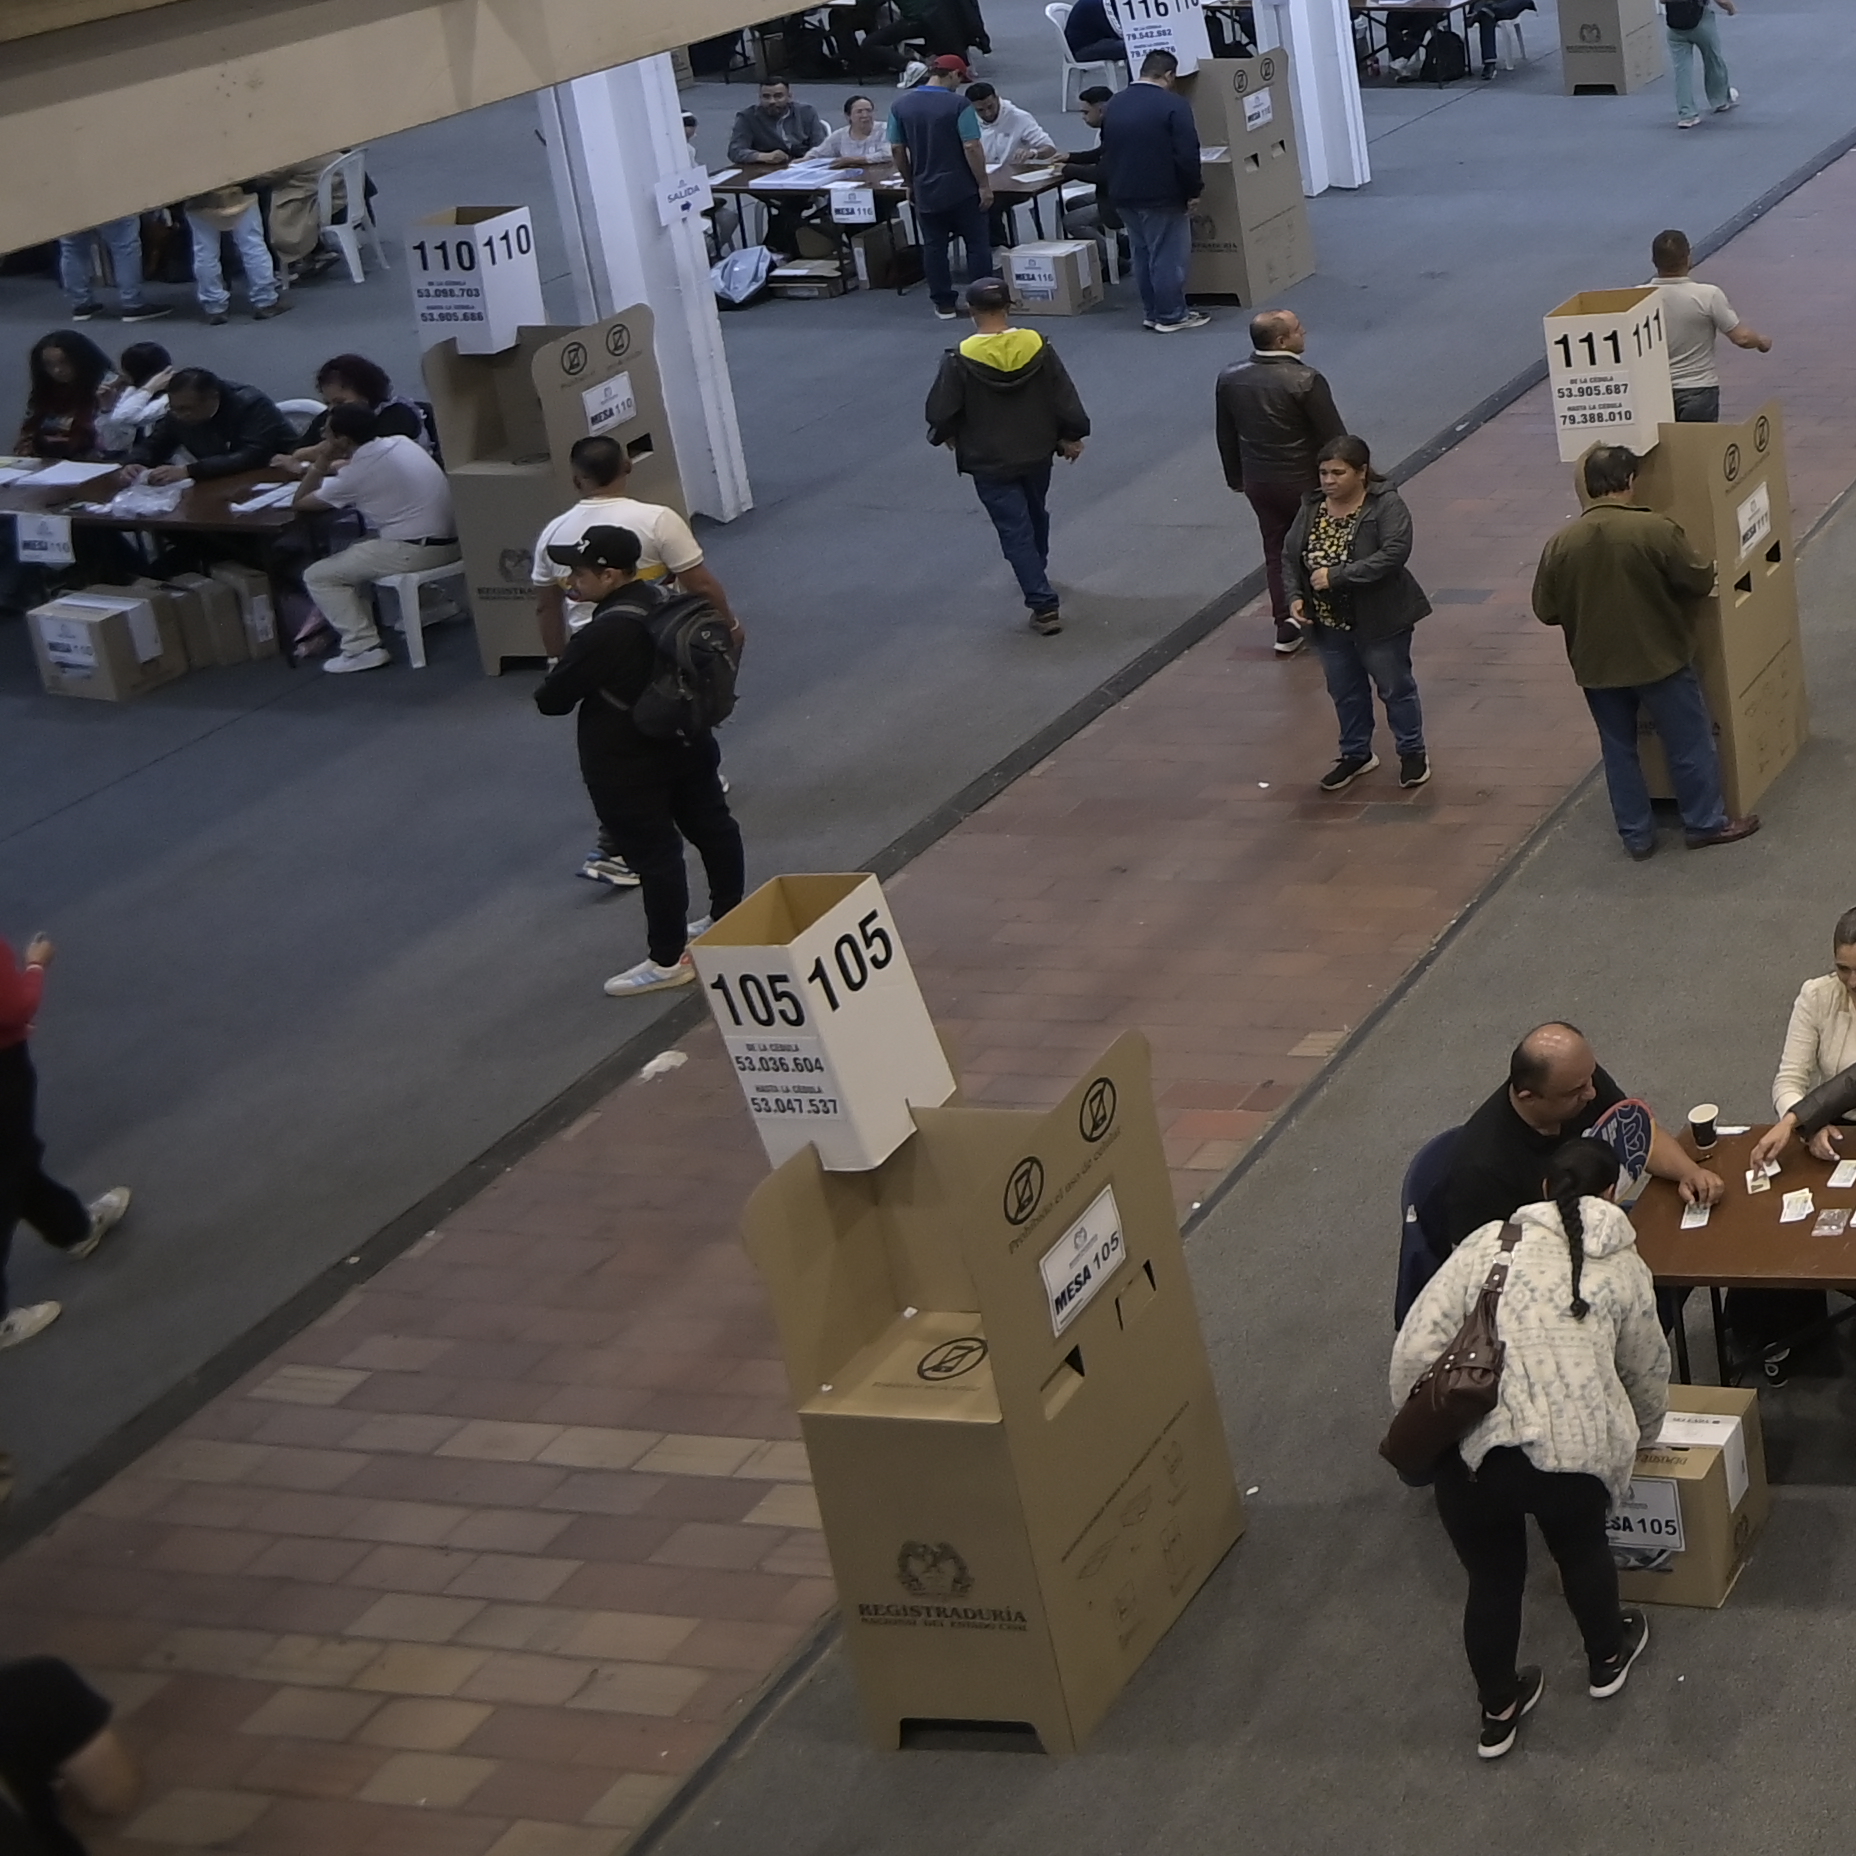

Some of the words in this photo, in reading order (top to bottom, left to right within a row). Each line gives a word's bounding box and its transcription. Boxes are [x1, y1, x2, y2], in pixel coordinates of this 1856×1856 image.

[668, 185, 701, 204] SALIDA
[834, 206, 855, 216] MESA
[483, 223, 532, 267] 110
[412, 239, 476, 272] 110
[1014, 273, 1036, 283] MESA
[1633, 307, 1663, 359] 111
[1553, 329, 1622, 369] 111
[1556, 383, 1630, 399] 53.905.687
[590, 406, 614, 426] MESA
[614, 398, 633, 415] 110
[1559, 409, 1633, 427] 79.388.010
[808, 908, 893, 1012] 105
[711, 972, 805, 1027] 105
[735, 1055, 825, 1073] 53.036.604
[751, 1097, 839, 1115] 53.047.537
[1054, 1264, 1092, 1316] MESA
[1092, 1230, 1120, 1271] 105
[1637, 1518, 1677, 1536] 105
[859, 1603, 1028, 1623] REGISTRADURÍA
